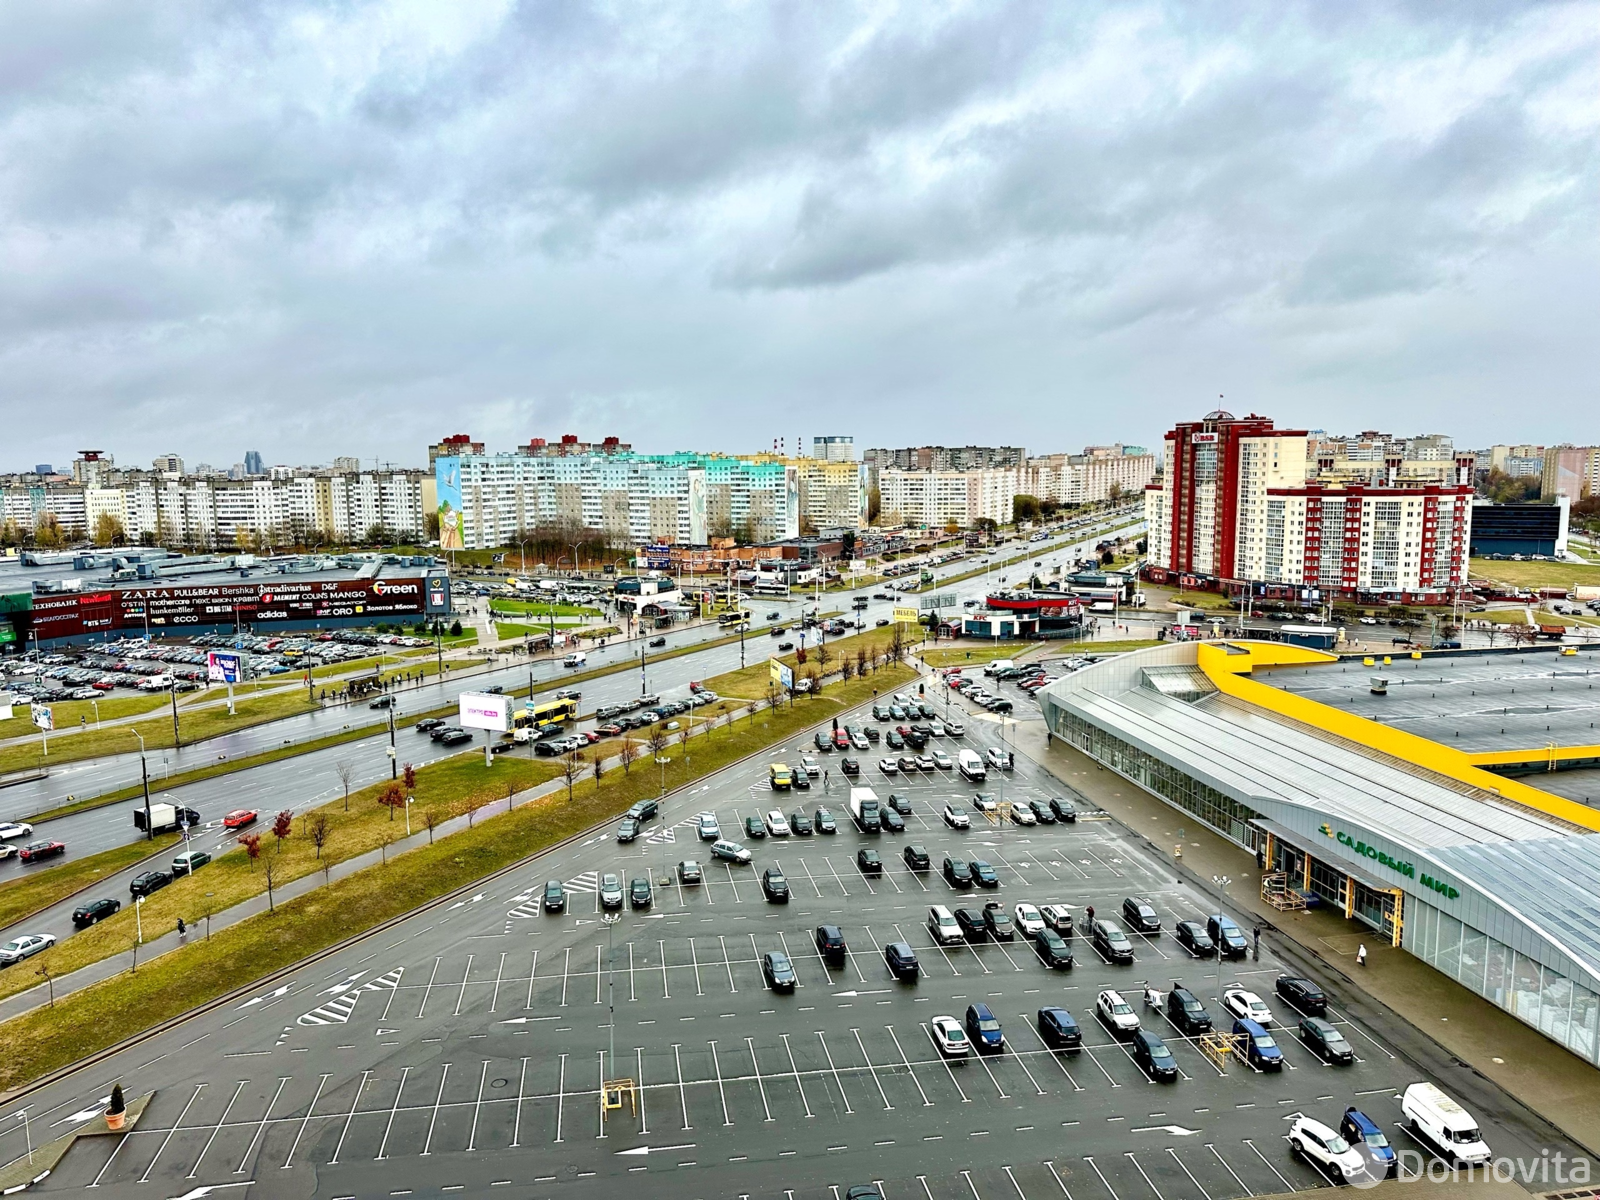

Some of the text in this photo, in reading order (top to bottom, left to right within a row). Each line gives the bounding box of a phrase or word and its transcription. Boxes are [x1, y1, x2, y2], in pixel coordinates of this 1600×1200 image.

[221, 587, 254, 595] Bershka
[321, 583, 338, 591] D&F
[373, 581, 417, 596] Green
[122, 590, 170, 599] ZARA
[174, 588, 219, 596] PULL&BEAR
[329, 591, 367, 599] MANGO
[257, 610, 288, 618] adidas
[173, 615, 199, 623] ecco
[1336, 831, 1461, 900] САДОВЫЙ МИР
